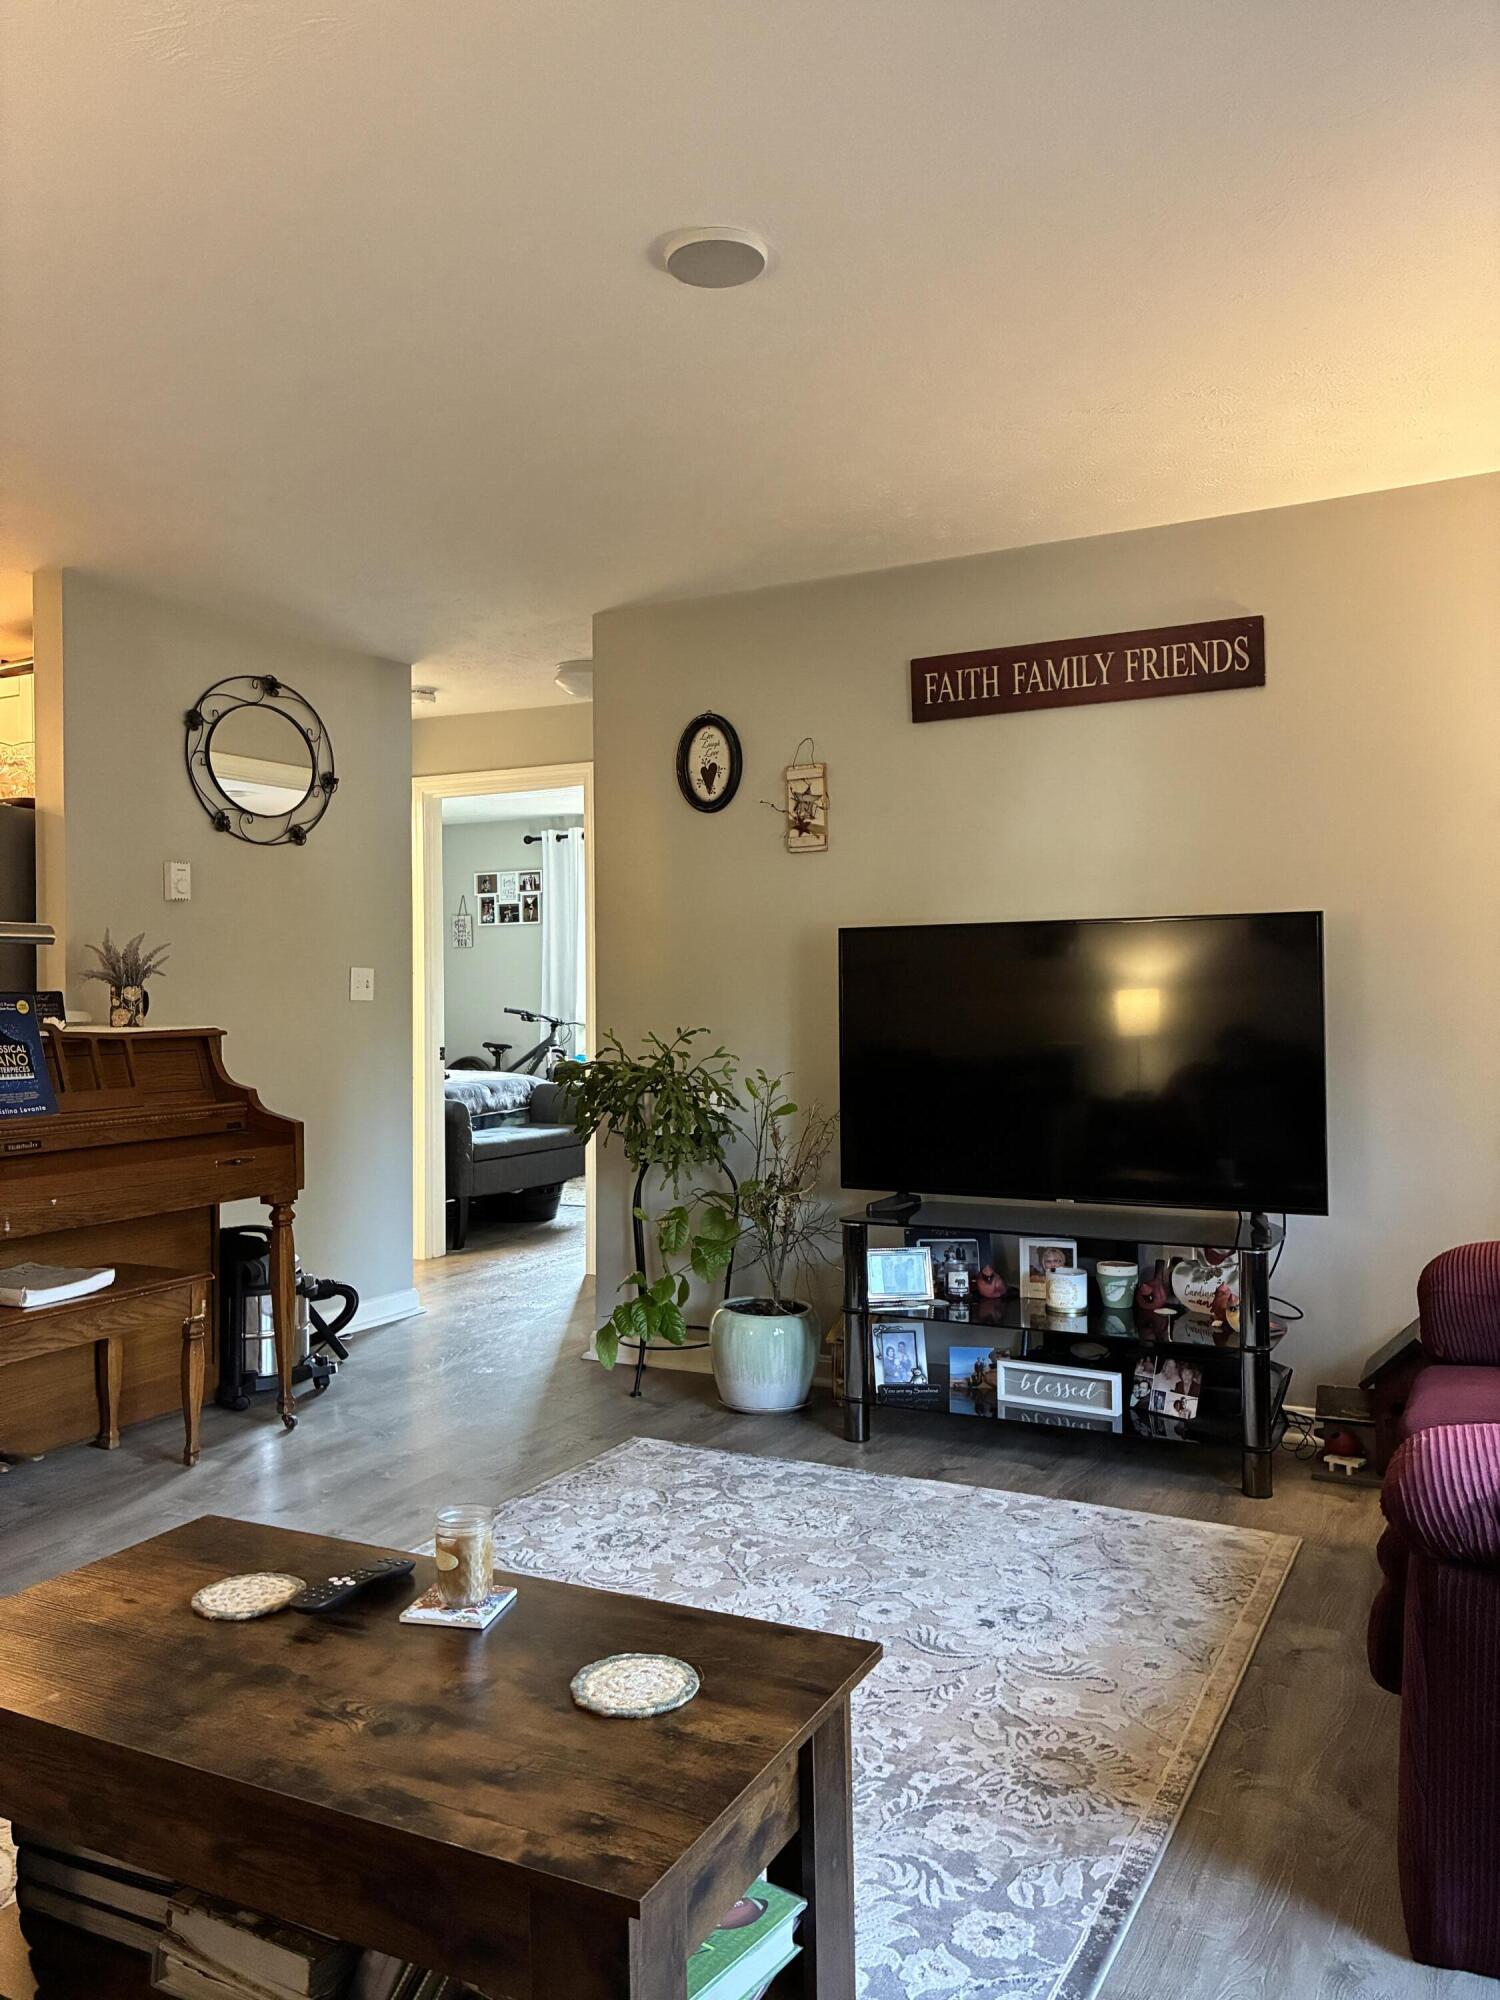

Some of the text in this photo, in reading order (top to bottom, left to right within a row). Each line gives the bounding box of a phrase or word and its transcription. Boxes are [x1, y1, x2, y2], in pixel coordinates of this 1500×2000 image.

[924, 635, 1250, 705] FAITH FAMILY FRIENDS
[702, 740, 720, 750] Laugh
[704, 748, 720, 758] Love
[1015, 1372, 1105, 1400] blessed
